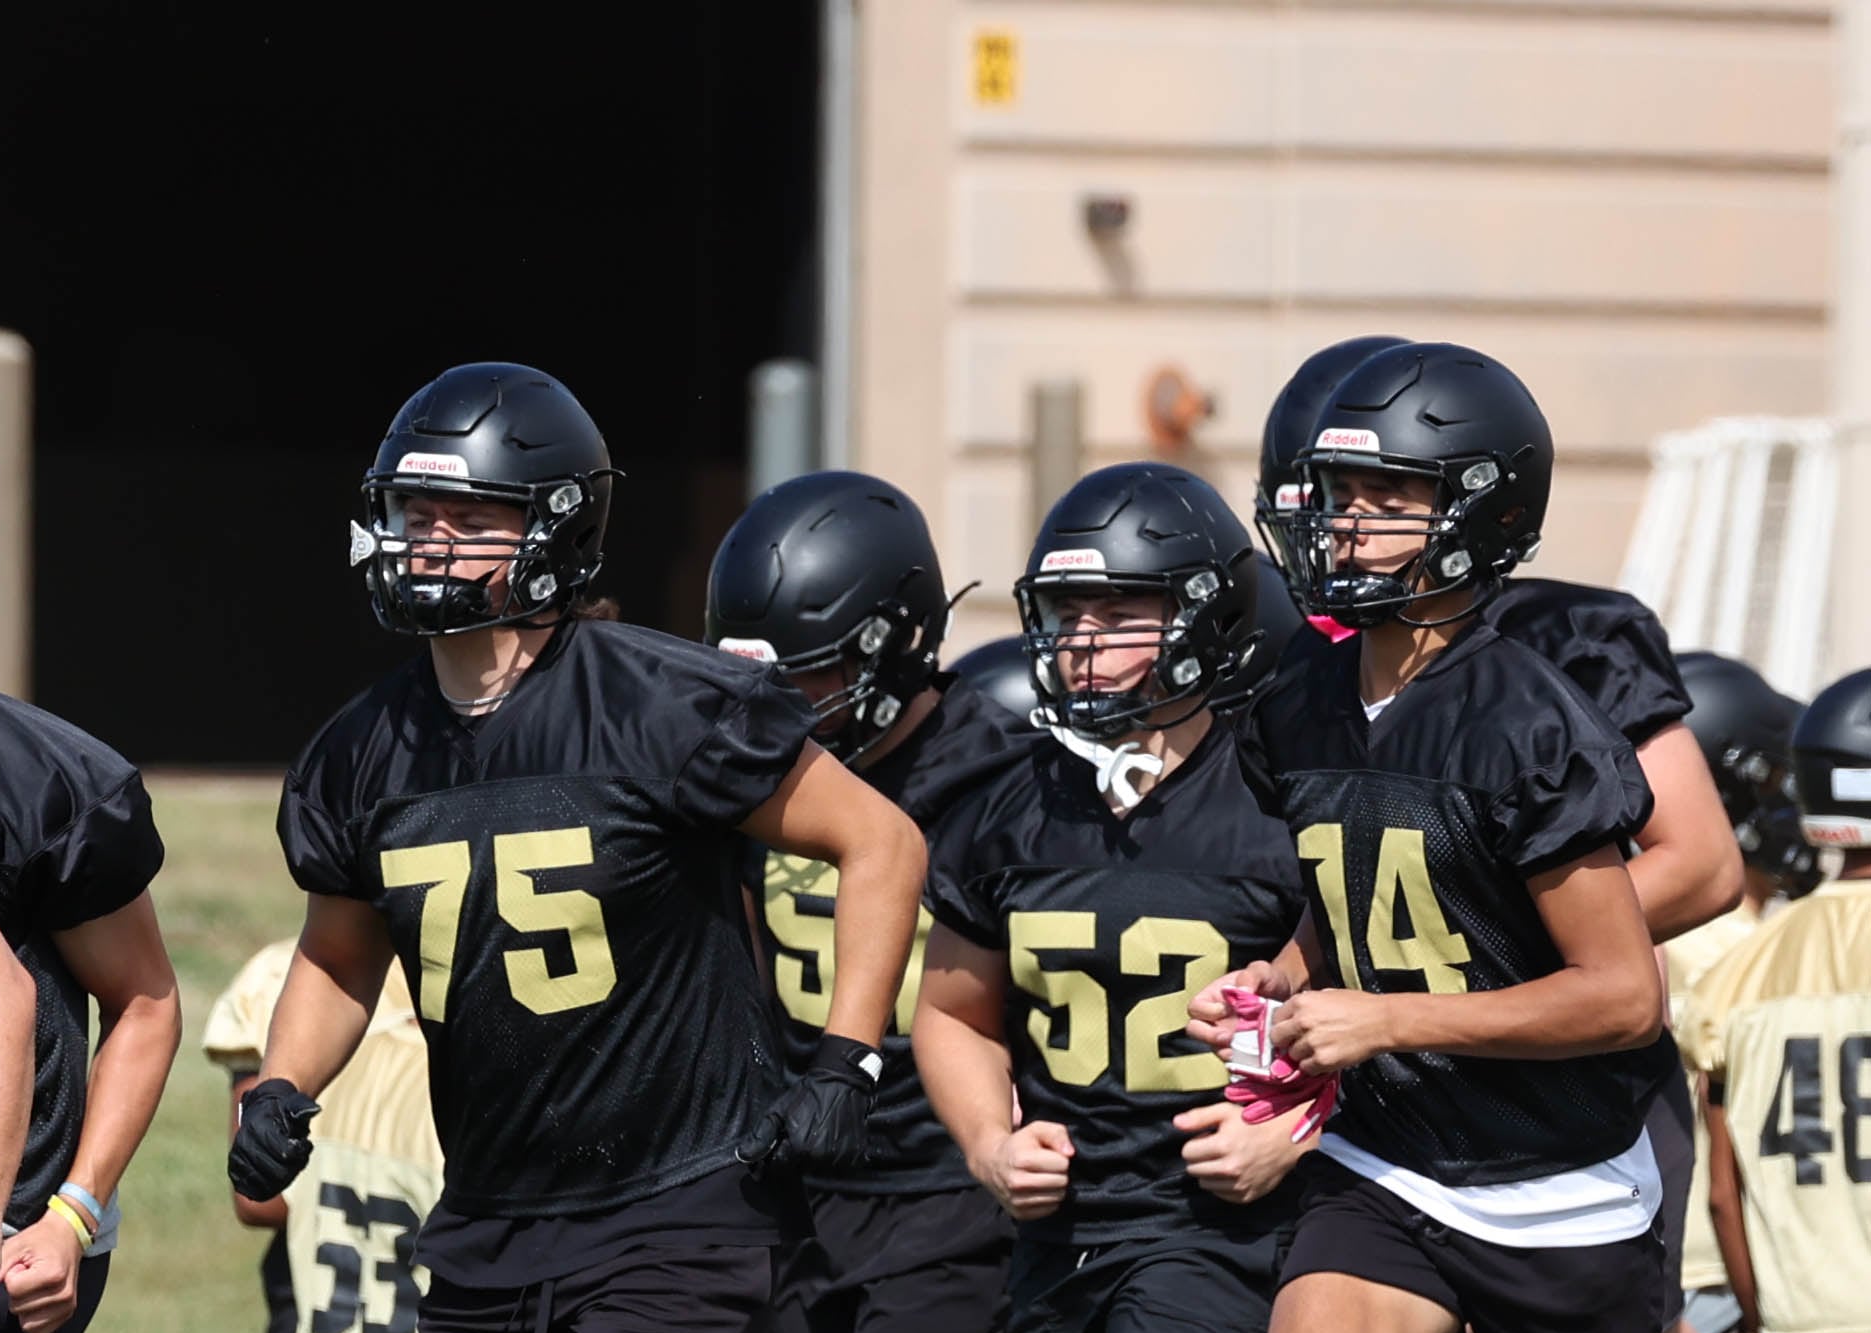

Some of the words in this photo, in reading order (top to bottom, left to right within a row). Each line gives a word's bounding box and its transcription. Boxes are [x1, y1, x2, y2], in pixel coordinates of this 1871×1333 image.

[404, 459, 458, 472] Riddell
[1322, 432, 1369, 446] Riddell
[1045, 554, 1095, 567] Riddell
[379, 826, 618, 1024] 75
[1297, 822, 1472, 995] 14
[1008, 910, 1231, 1093] 52
